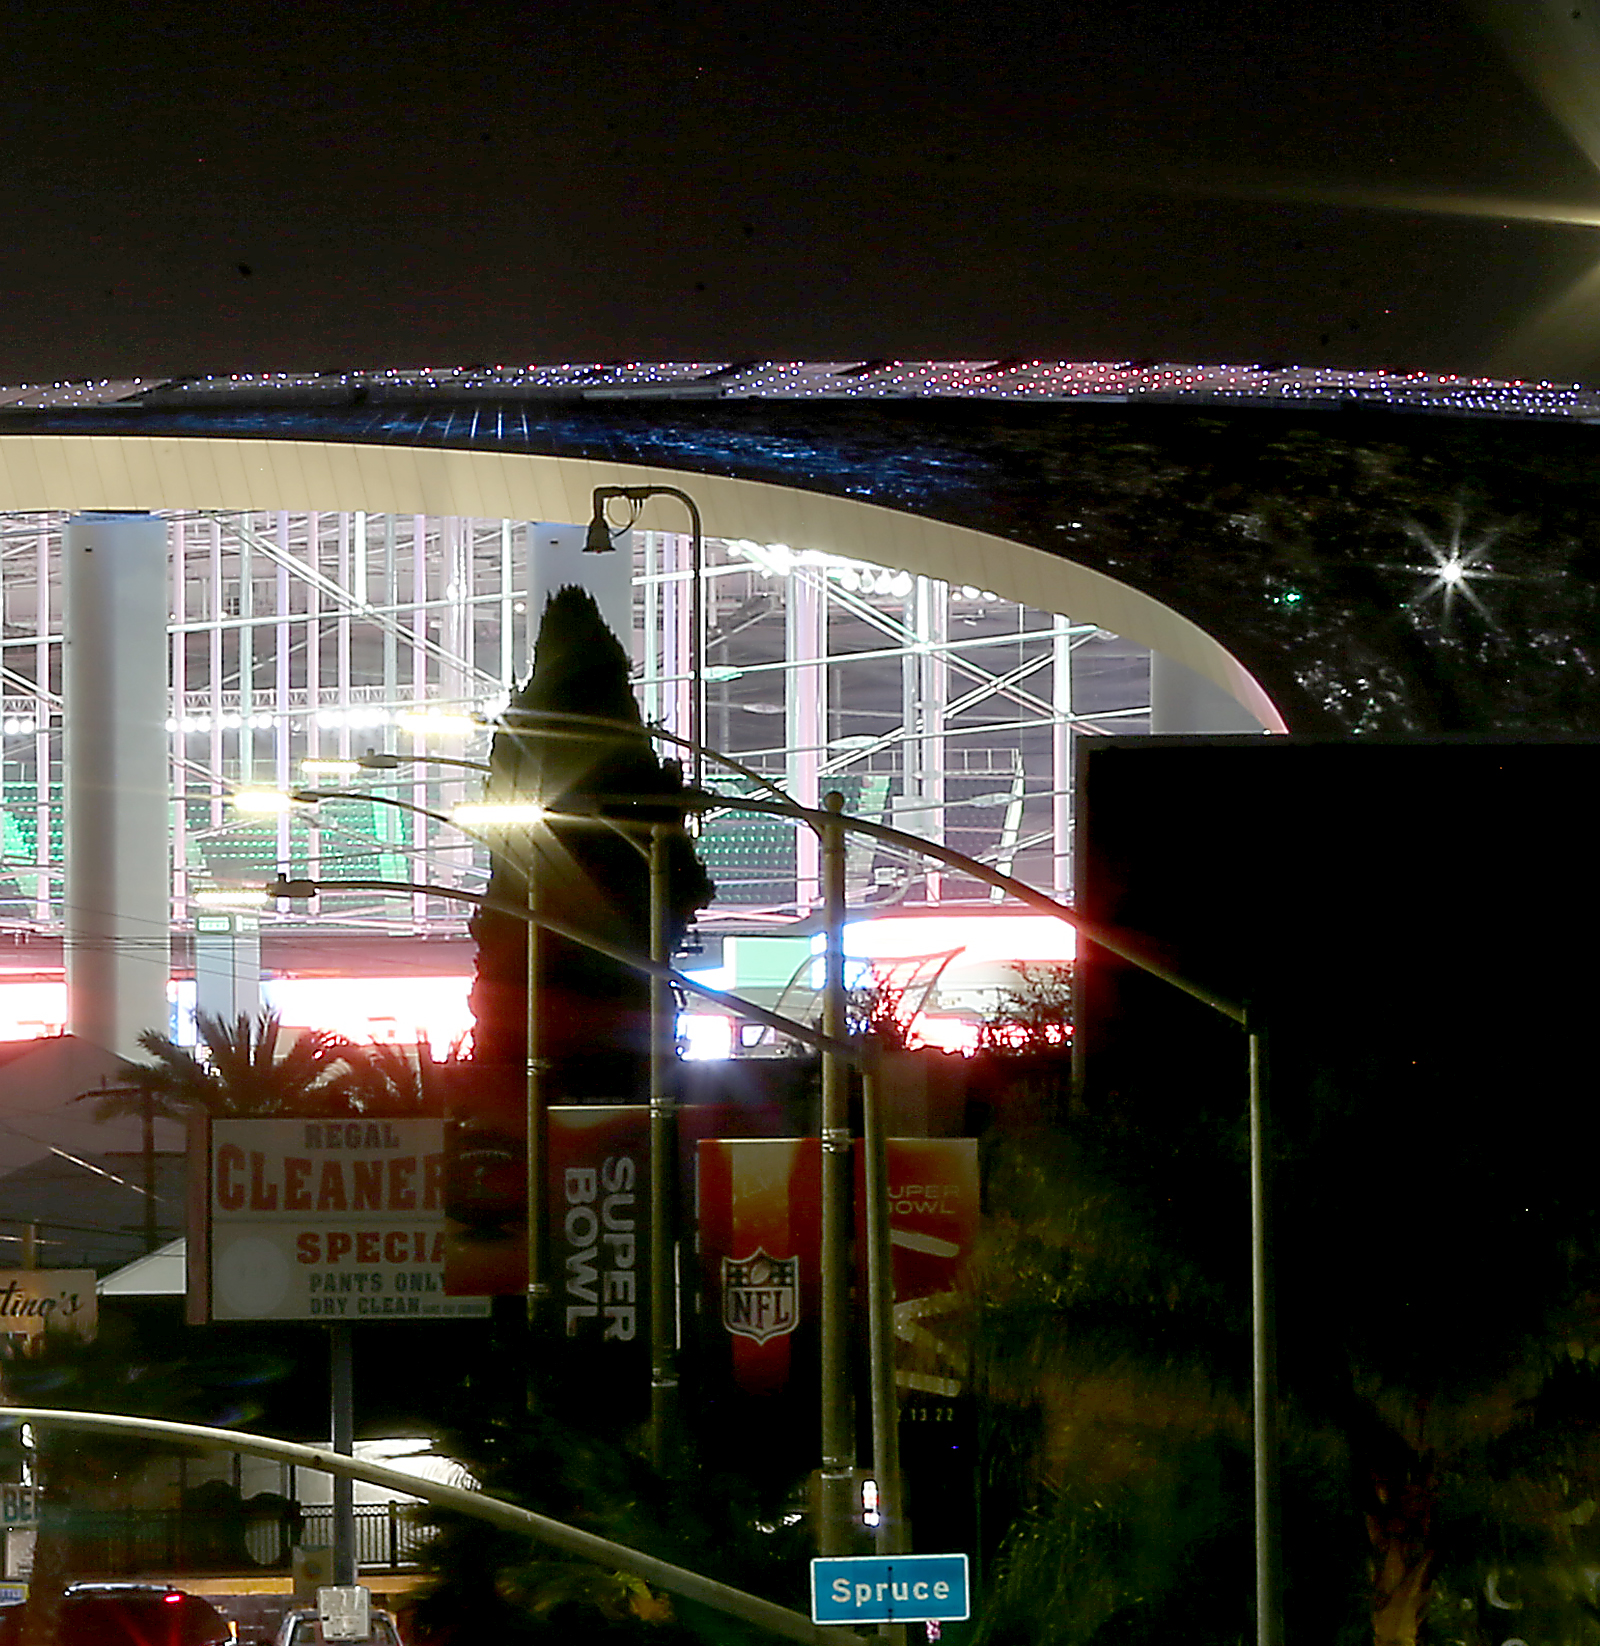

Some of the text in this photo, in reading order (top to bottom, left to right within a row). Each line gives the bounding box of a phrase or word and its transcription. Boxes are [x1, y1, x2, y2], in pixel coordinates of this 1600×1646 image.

[304, 1122, 400, 1149] REGAL
[216, 1144, 447, 1211] CLEANER
[886, 1184, 961, 1199] UPER
[889, 1201, 956, 1215] OWL
[295, 1232, 447, 1265] SPECIA
[564, 1167, 599, 1338] BOWL
[601, 1155, 637, 1343] SUPER
[309, 1272, 383, 1293] PANTS
[310, 1297, 349, 1315] DRY
[358, 1297, 420, 1315] CLEAN
[730, 1289, 791, 1330] NFL
[3, 1490, 33, 1522] BE
[831, 1577, 950, 1608] Spruce
